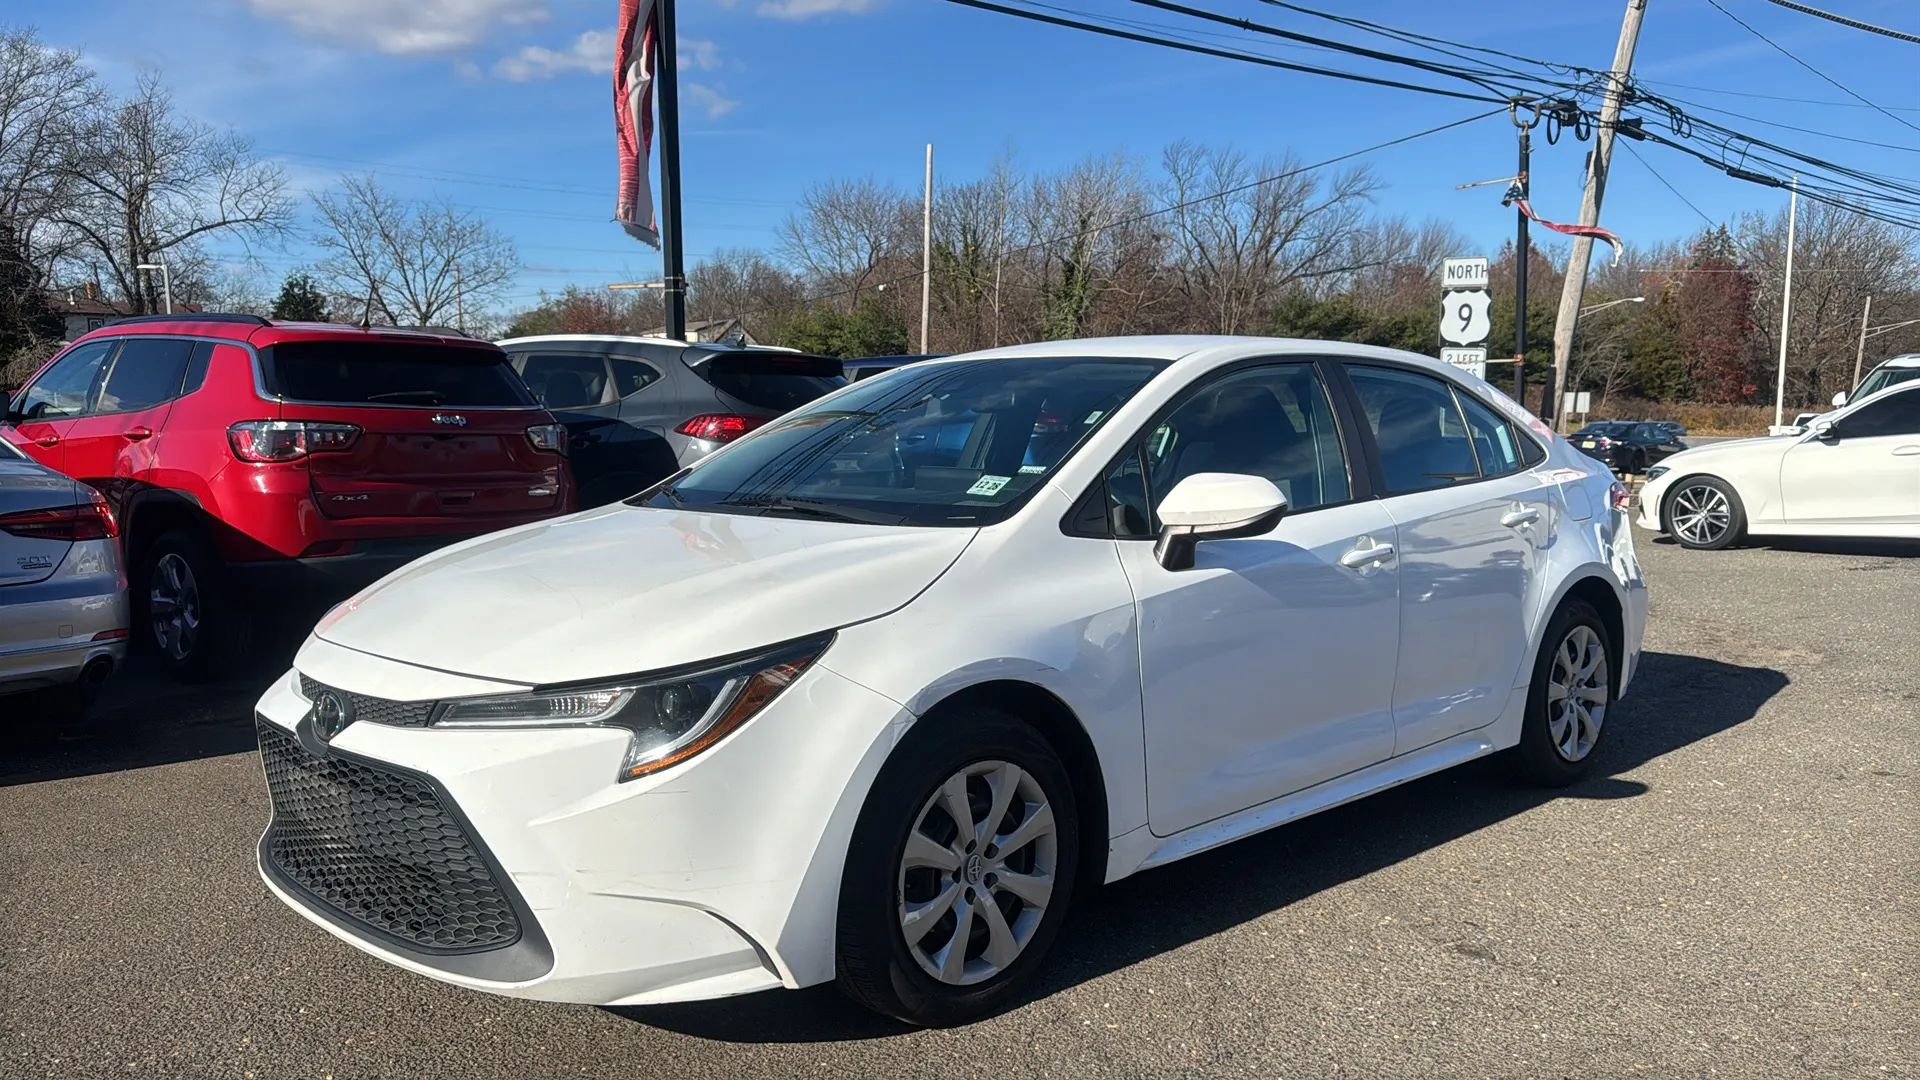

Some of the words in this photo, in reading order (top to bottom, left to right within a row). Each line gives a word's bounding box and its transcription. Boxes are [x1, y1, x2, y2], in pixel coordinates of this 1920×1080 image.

[1447, 264, 1488, 279] NORTH
[1458, 303, 1473, 332] 9
[1446, 354, 1453, 364] 2
[1456, 354, 1481, 365] LEFT
[431, 412, 466, 427] Jeep
